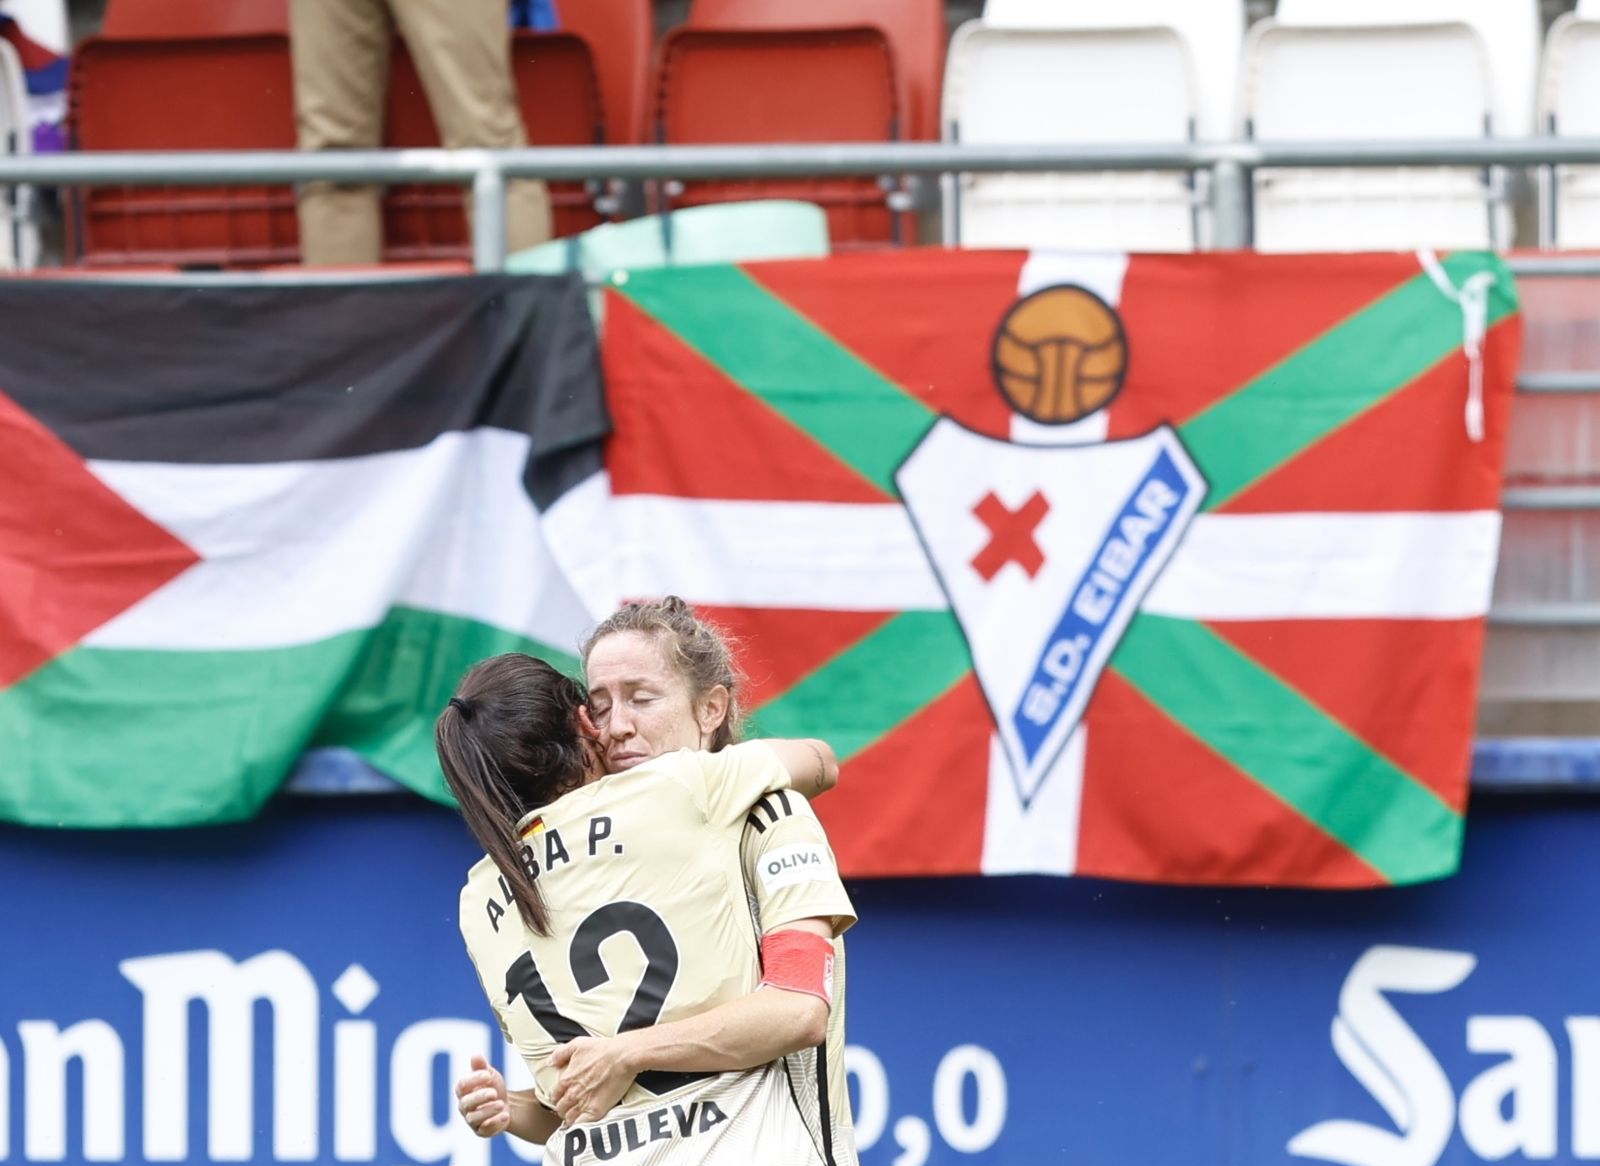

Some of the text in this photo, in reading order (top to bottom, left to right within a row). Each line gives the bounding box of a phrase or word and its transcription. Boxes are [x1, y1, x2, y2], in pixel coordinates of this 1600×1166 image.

[1072, 479, 1180, 625] EIBAR
[486, 816, 623, 933] ALBA P.
[767, 852, 821, 875] OLIVA
[0, 1018, 125, 1162] n
